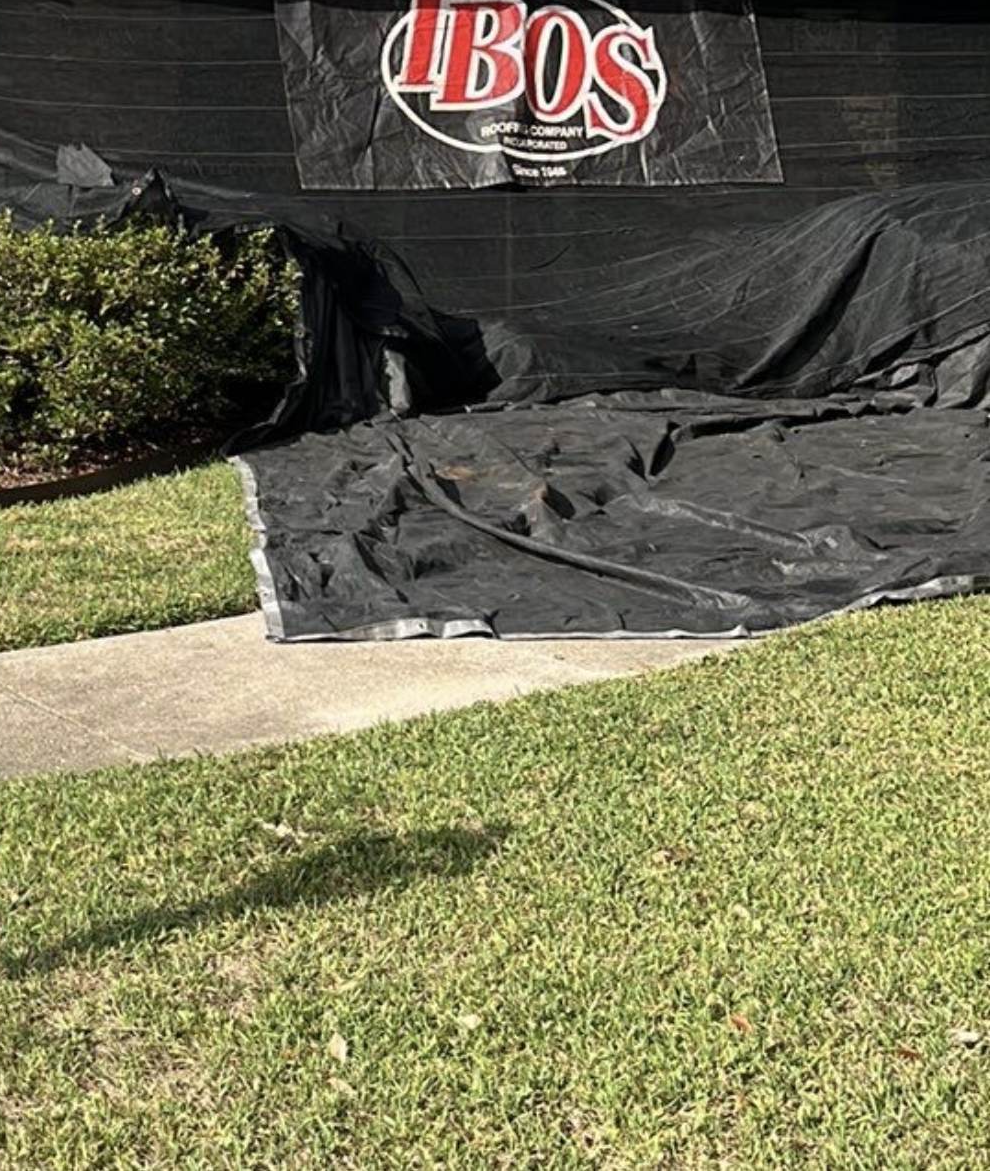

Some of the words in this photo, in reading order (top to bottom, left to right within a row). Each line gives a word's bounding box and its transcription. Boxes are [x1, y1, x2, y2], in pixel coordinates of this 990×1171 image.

[481, 121, 529, 137] ROOFI
[531, 126, 583, 138] COMPANY
[512, 163, 540, 177] Since
